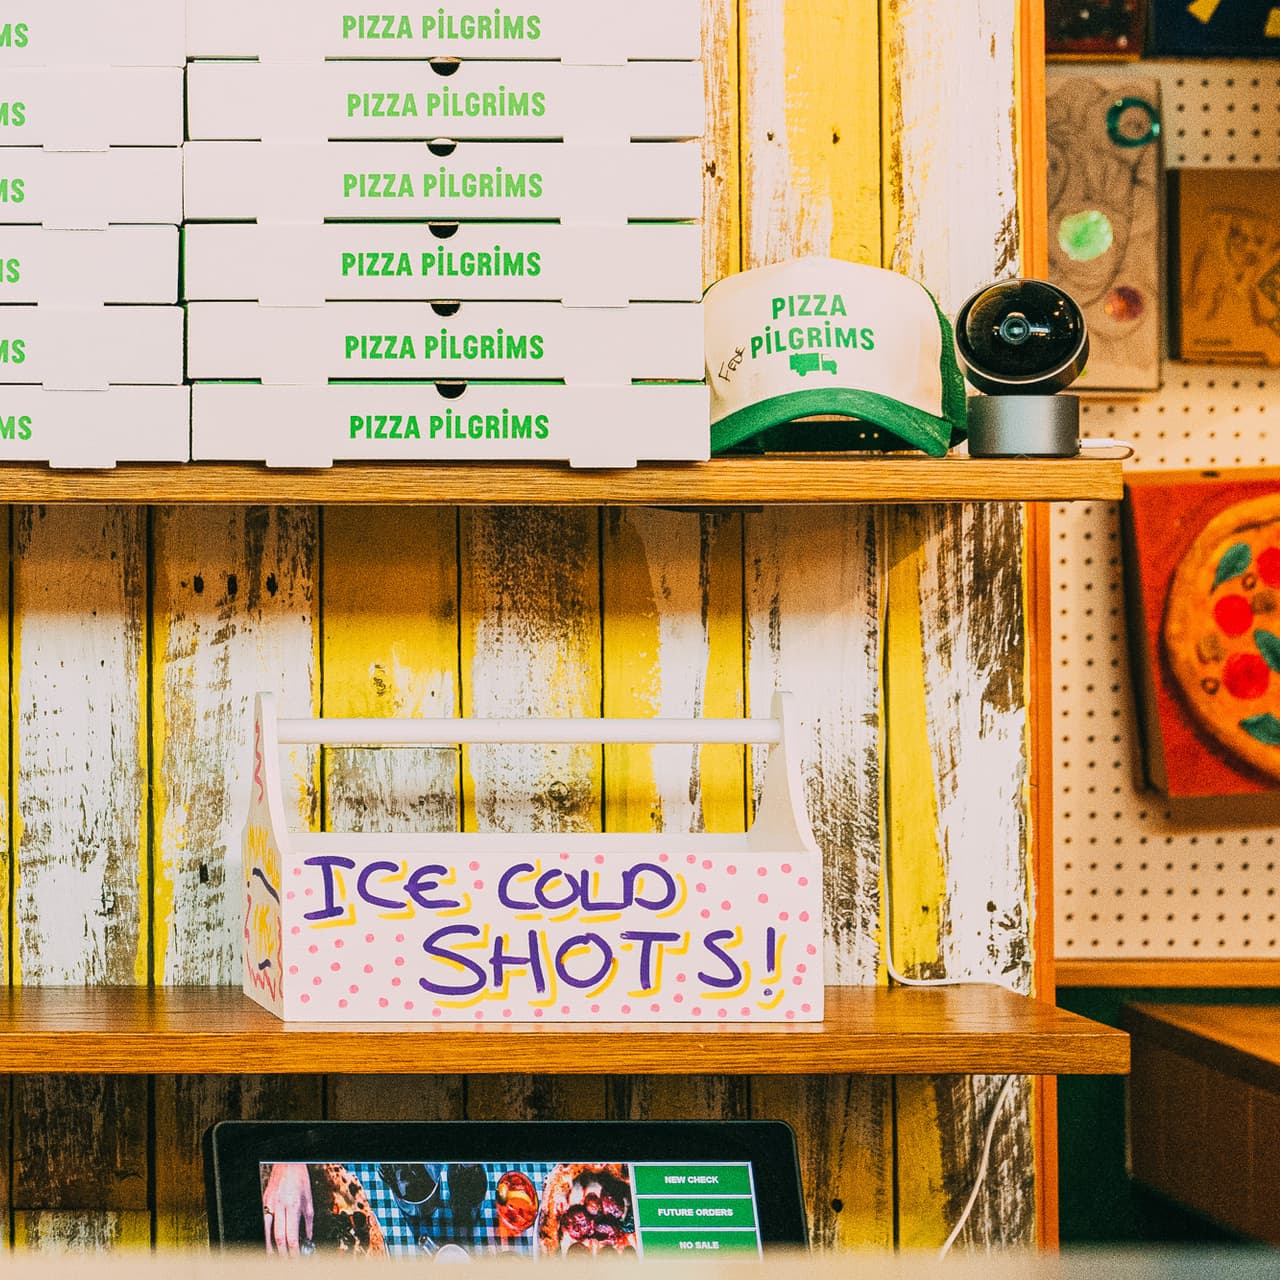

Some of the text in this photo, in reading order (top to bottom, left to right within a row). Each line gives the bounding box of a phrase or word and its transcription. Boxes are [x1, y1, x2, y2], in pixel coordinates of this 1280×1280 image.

[348, 93, 417, 117] PIZZA
[342, 252, 413, 277] PIZZA
[772, 294, 847, 319] PIZZA
[345, 336, 416, 359] PIZZA
[350, 415, 421, 439] PIZZA
[302, 855, 679, 923] ICE COLD
[418, 923, 779, 999] SHOTS!
[664, 1175, 719, 1184] NEW CHECK
[658, 1208, 733, 1217] FUTURE ORDERS
[679, 1241, 720, 1249] NO SALE
